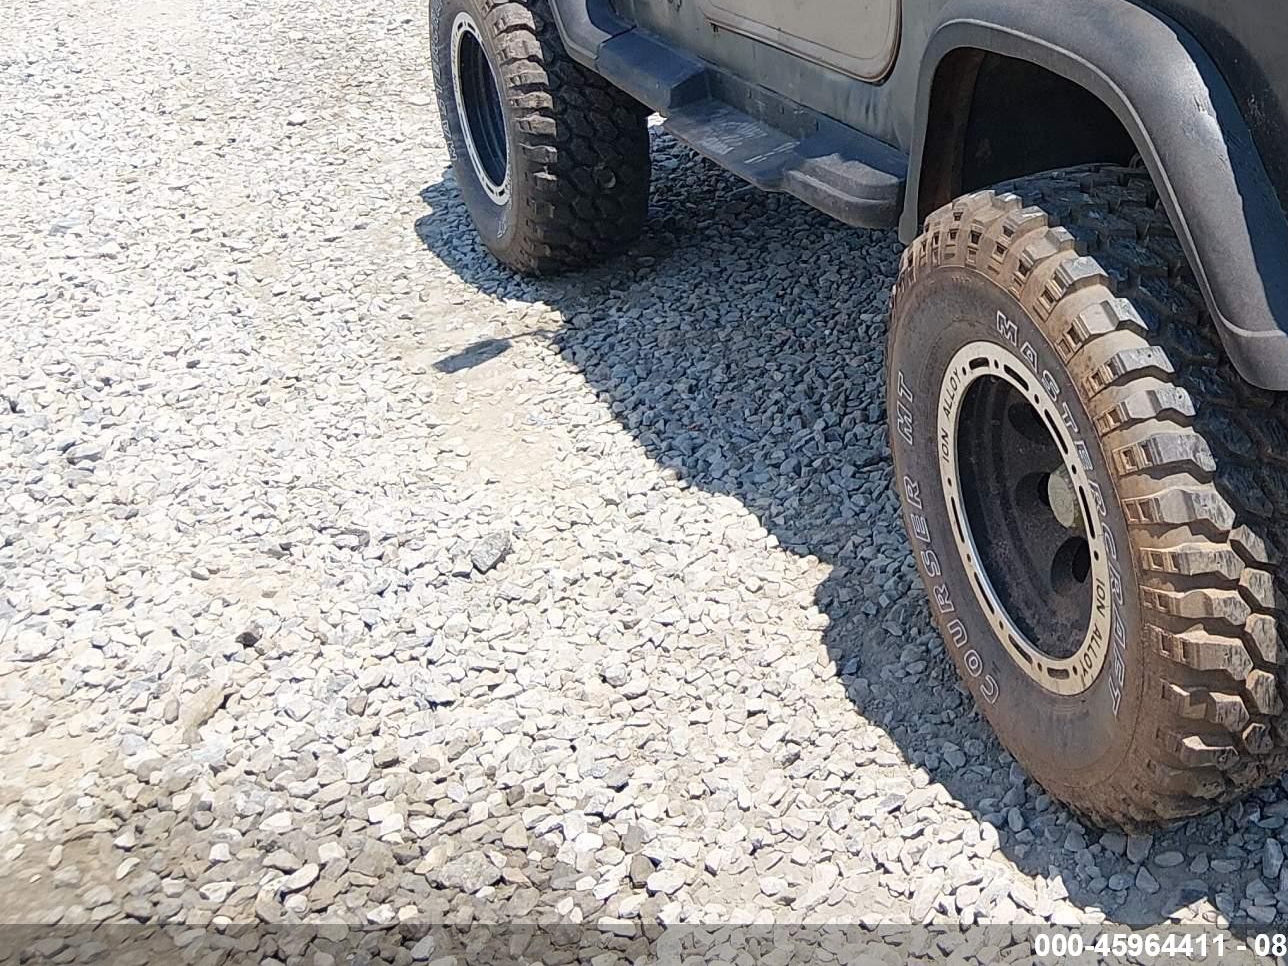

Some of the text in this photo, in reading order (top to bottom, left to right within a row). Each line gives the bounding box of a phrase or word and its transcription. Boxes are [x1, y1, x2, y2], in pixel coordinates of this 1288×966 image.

[941, 368, 961, 463] ION ALLOY
[896, 371, 999, 704] COURSER MT
[1080, 578, 1106, 679] ION ALLOY
